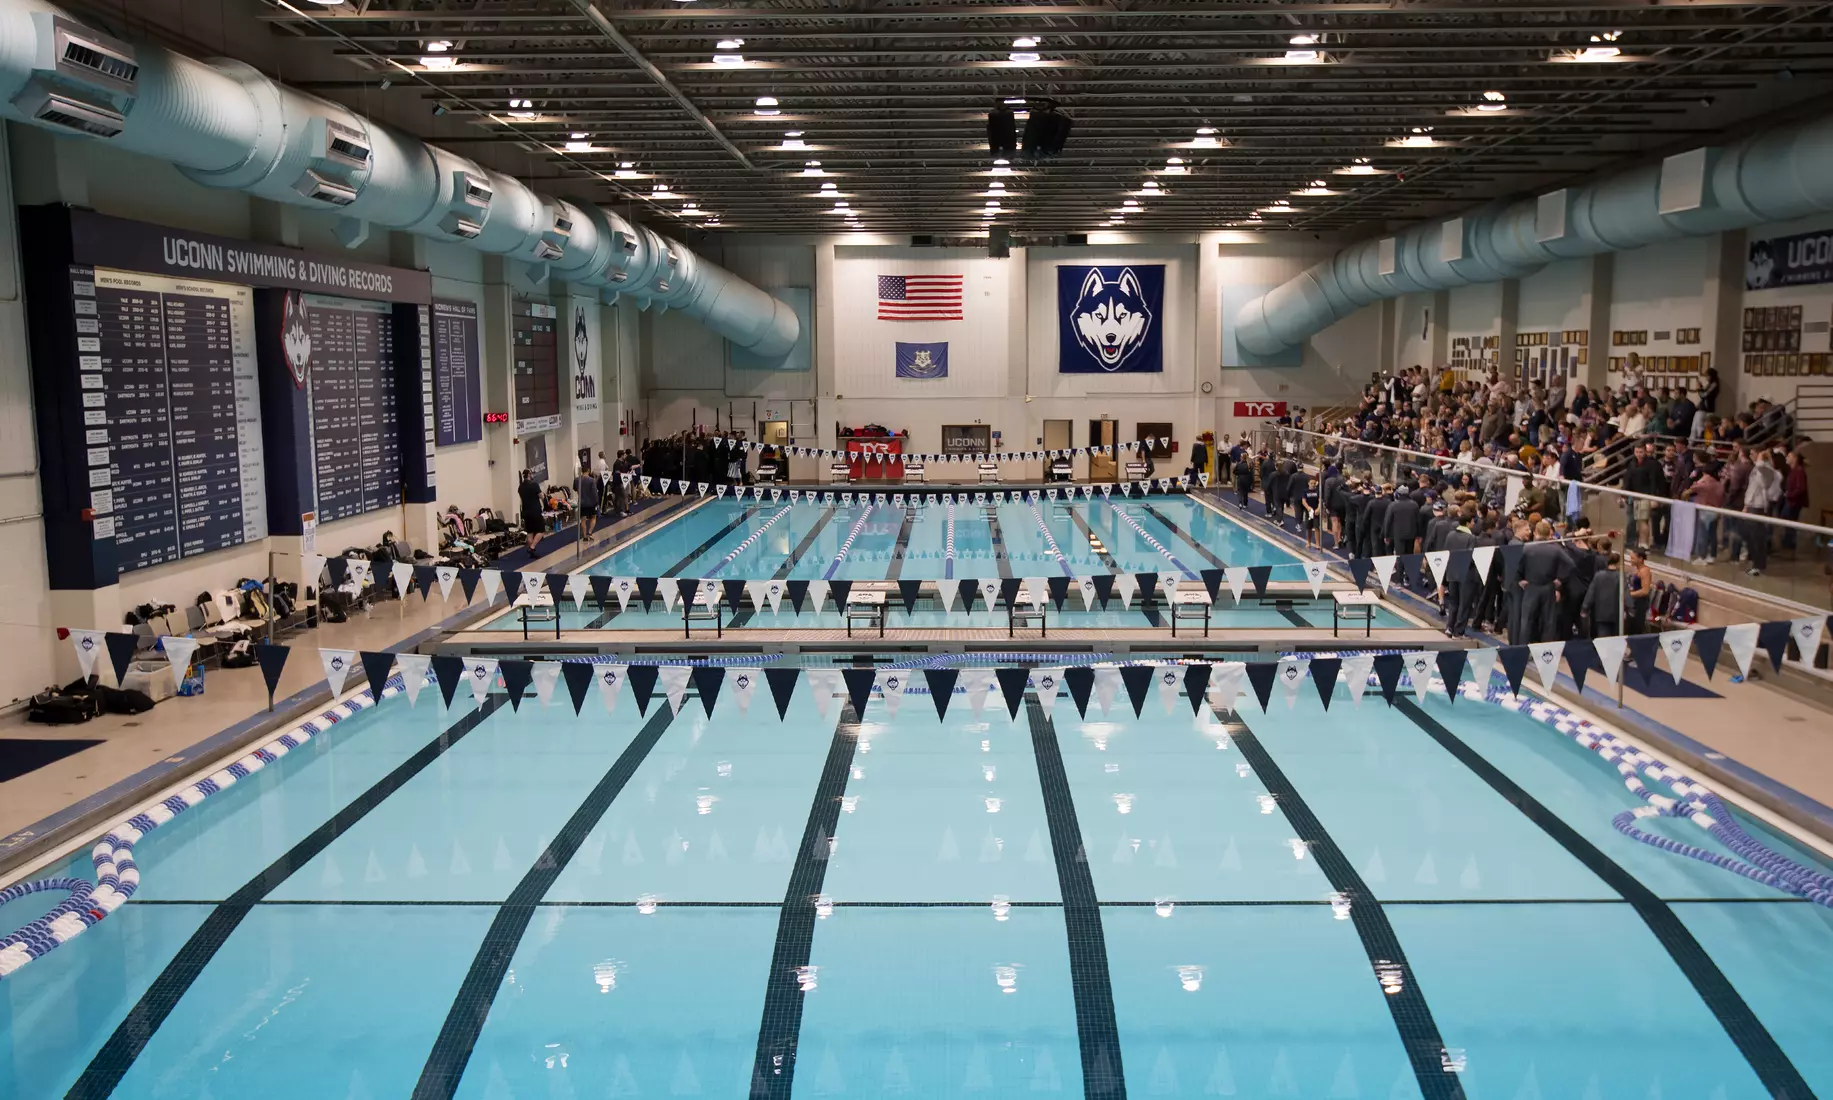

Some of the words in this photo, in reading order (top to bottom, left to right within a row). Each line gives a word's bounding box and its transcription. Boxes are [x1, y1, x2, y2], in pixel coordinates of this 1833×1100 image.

[1788, 235, 1833, 268] UCO
[163, 236, 223, 271] UCONN
[227, 249, 295, 280] SWIMMING
[299, 260, 307, 281] &
[310, 262, 347, 287] DIVING
[349, 269, 393, 293] RECORDS
[435, 303, 451, 312] WOMEN'S
[452, 305, 461, 313] HALL
[575, 375, 595, 399] CONN
[1245, 403, 1275, 416] TYR
[860, 442, 889, 454] TYR
[947, 438, 985, 446] UCONN
